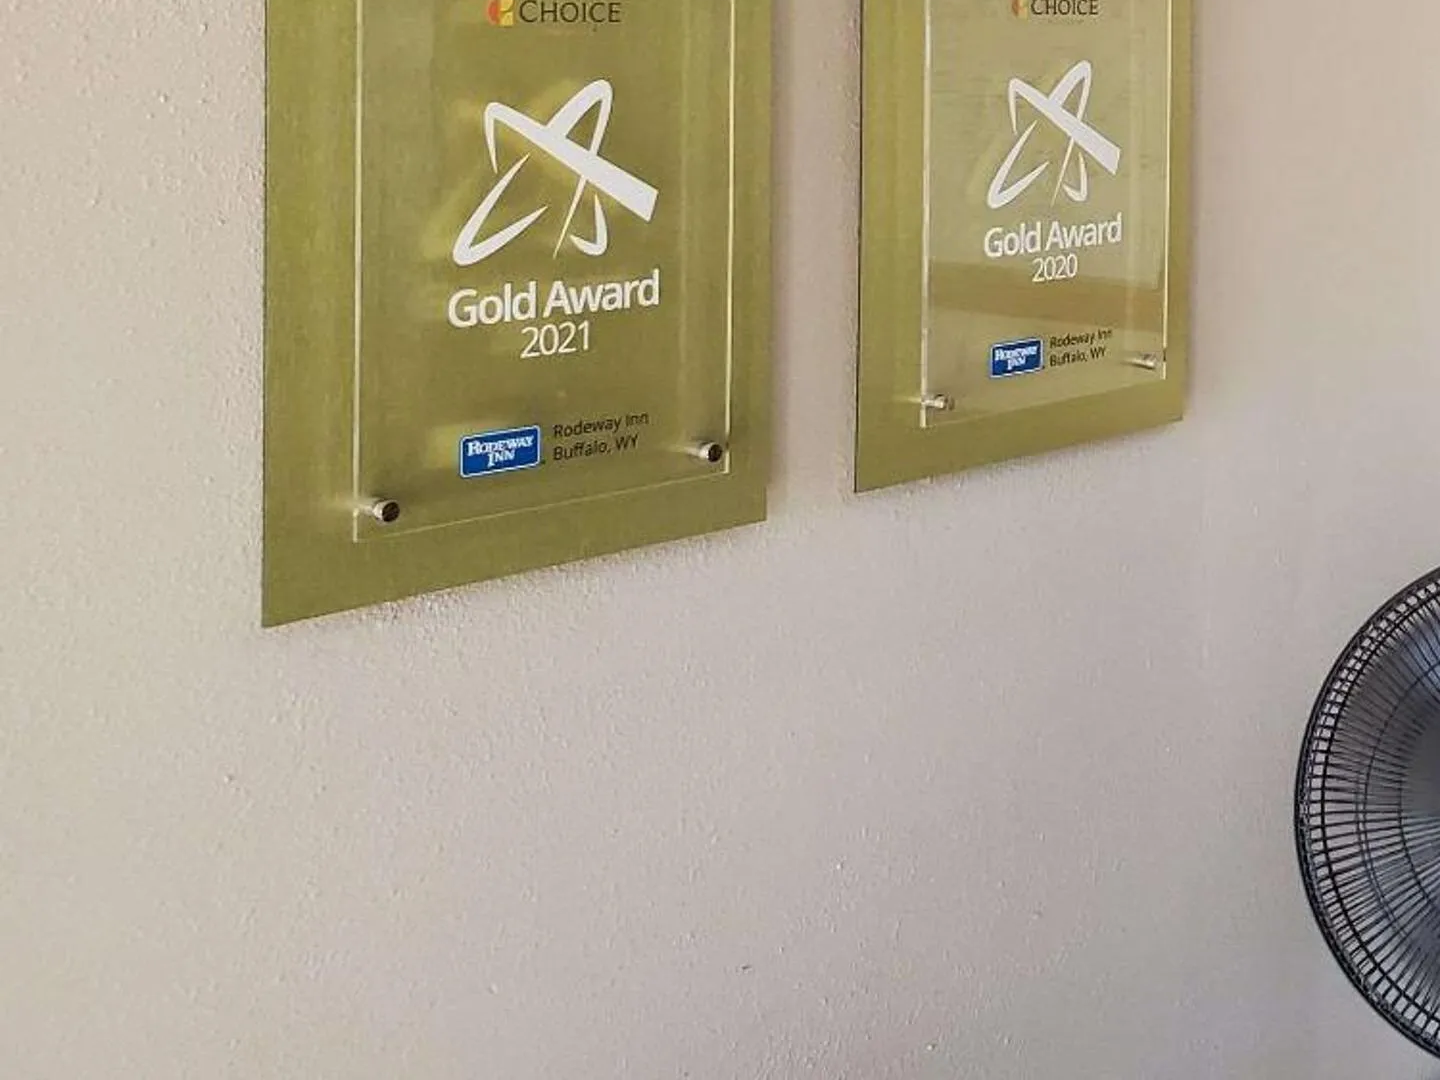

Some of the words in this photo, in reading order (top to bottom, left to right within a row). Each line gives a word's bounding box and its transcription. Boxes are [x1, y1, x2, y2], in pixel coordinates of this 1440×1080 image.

[984, 221, 1042, 259] Gold
[1046, 212, 1123, 252] Award
[1032, 253, 1078, 282] 2020
[448, 279, 537, 329] Gold
[543, 269, 660, 319] Award
[520, 320, 590, 359] 2021
[1049, 332, 1095, 349] Rodeway
[1049, 349, 1089, 367] Buffalo,
[1090, 345, 1107, 359] WY
[553, 416, 622, 438] Rodeway
[625, 412, 649, 426] Inn
[553, 439, 612, 461] Buffalo,
[615, 432, 639, 450] WY
